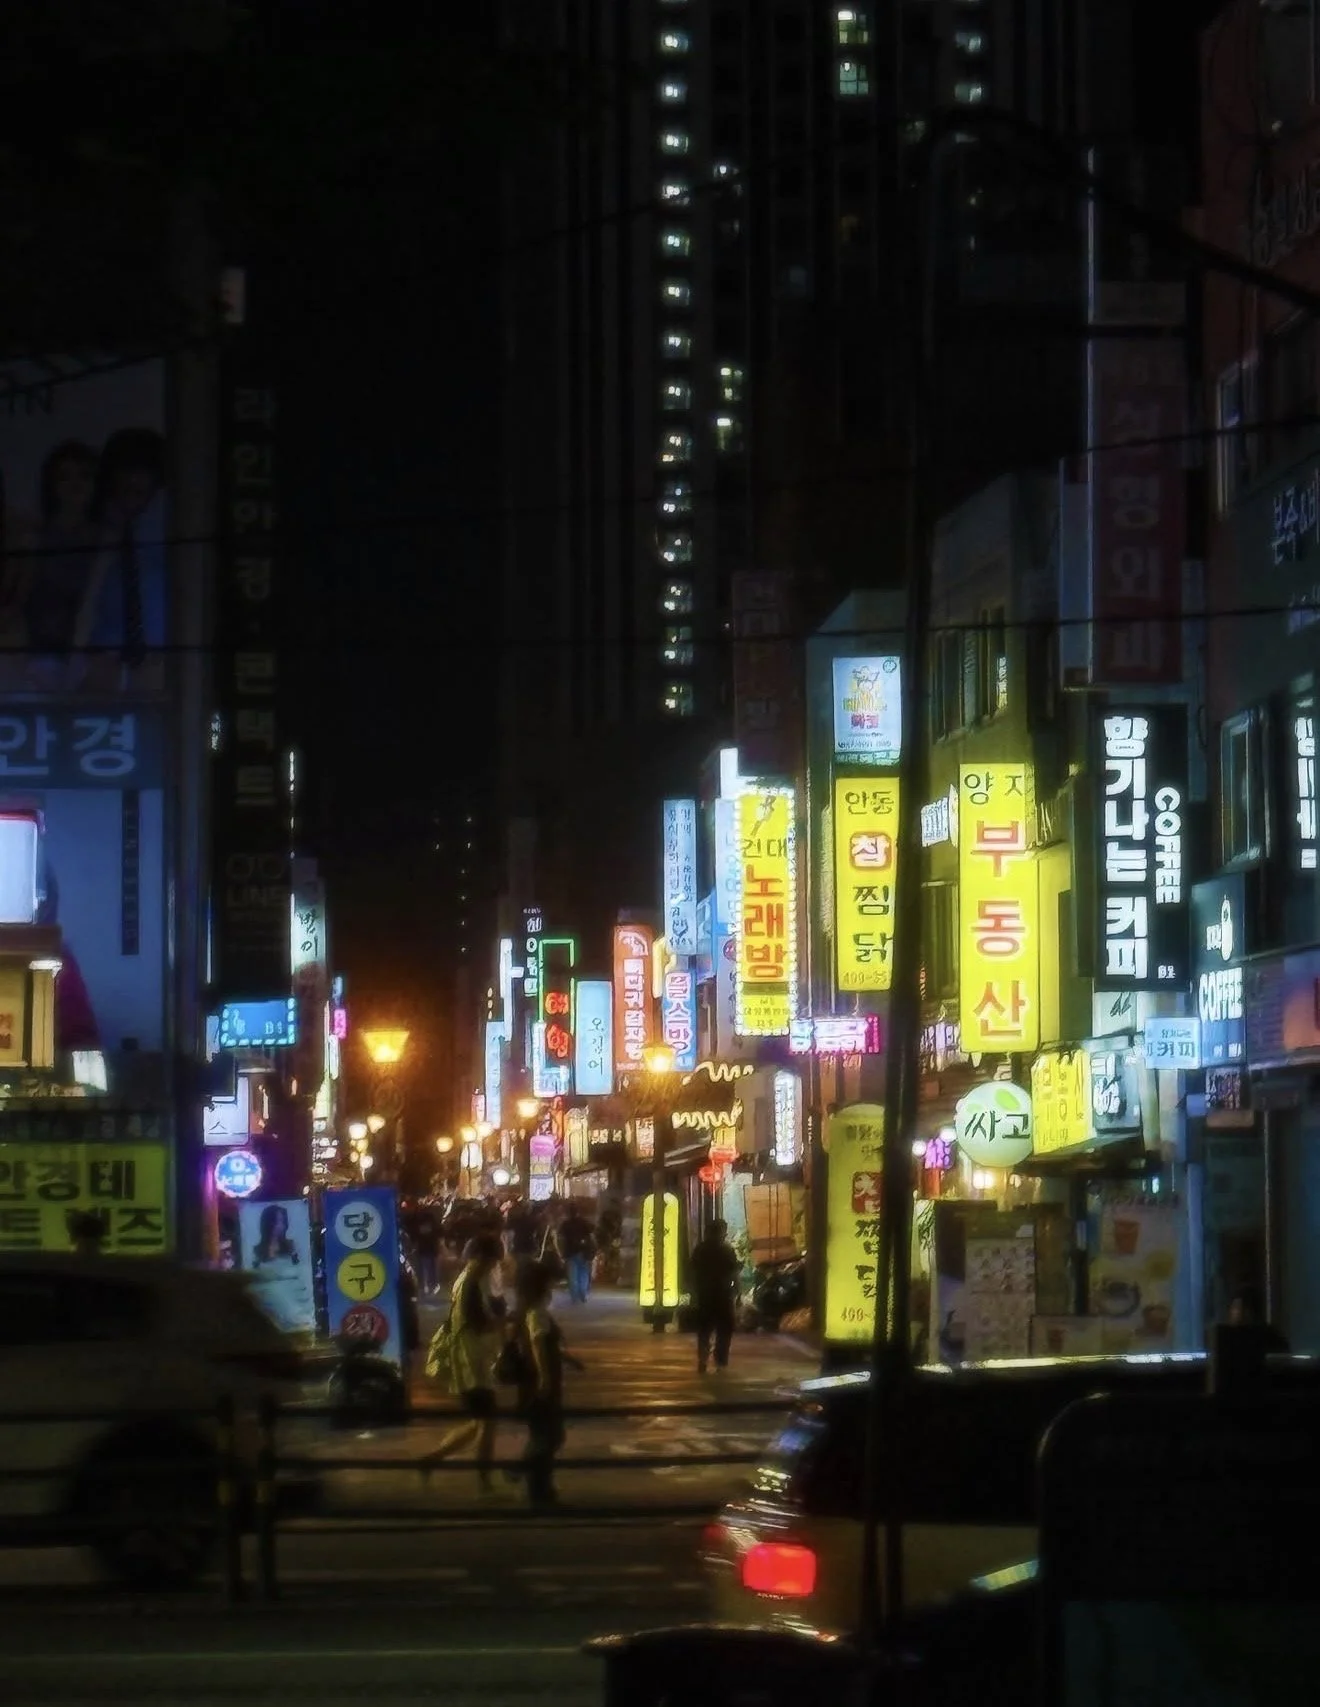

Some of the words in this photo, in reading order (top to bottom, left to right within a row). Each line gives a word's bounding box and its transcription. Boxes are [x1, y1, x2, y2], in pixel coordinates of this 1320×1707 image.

[0, 712, 137, 777] 안경
[845, 791, 894, 815] 안동
[1103, 716, 1149, 882] 향기나는
[742, 838, 788, 859] 건대
[1153, 786, 1182, 904] COFFEE
[743, 864, 789, 979] 노래방
[970, 820, 1027, 1038] 부동산
[1105, 896, 1148, 979] 커피
[1199, 967, 1244, 1023] COFFEE
[965, 1110, 1031, 1142] 싸고
